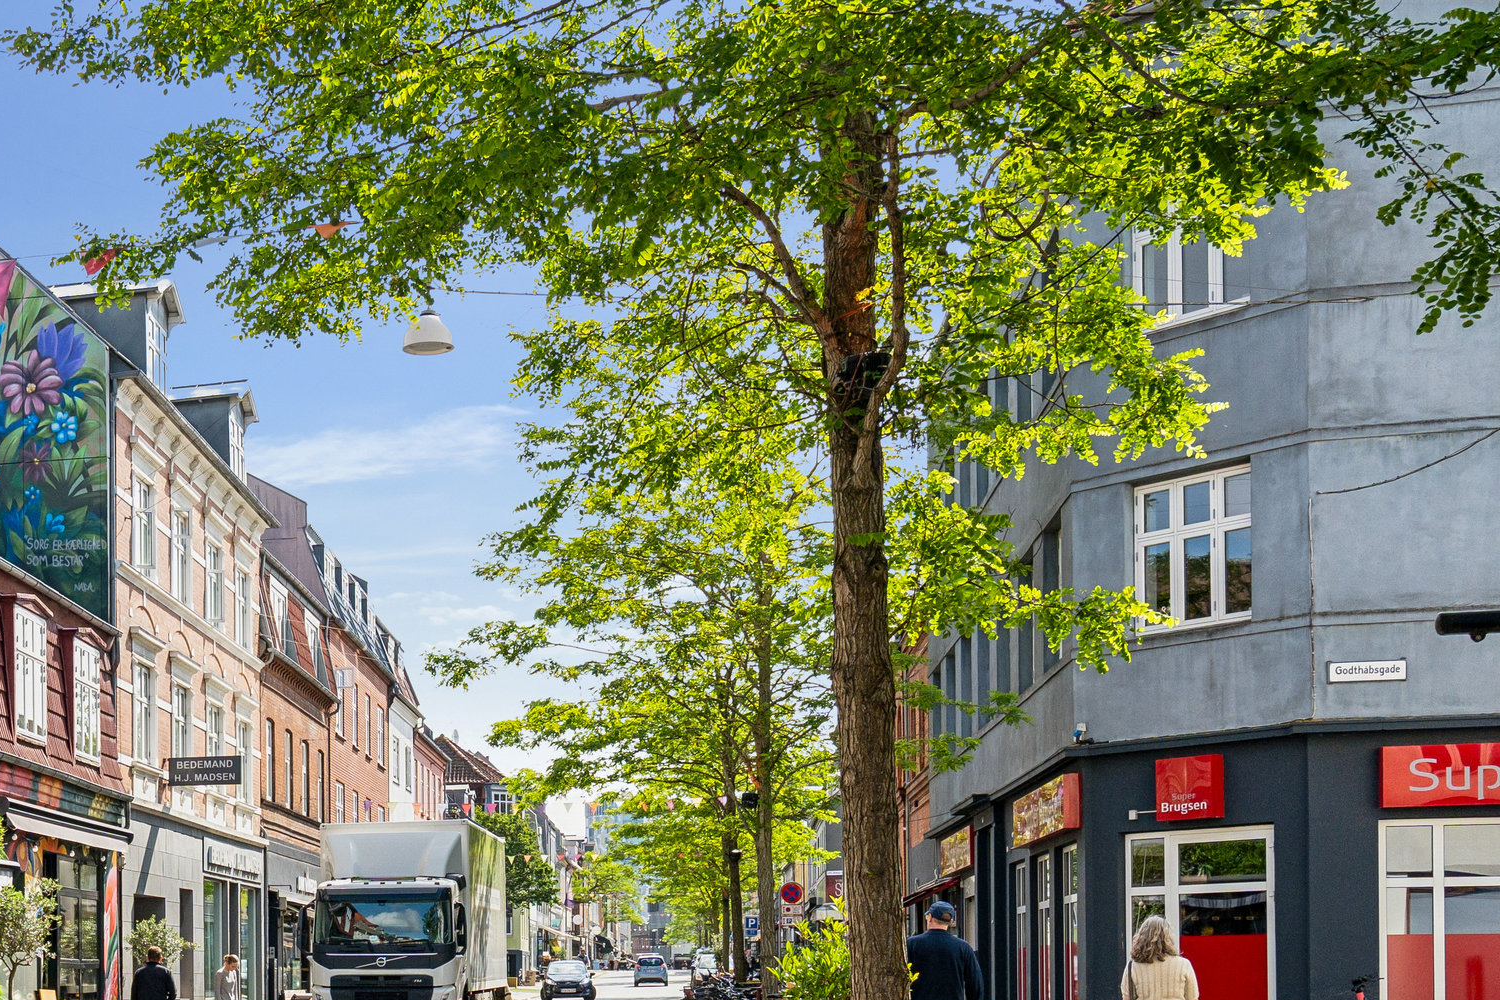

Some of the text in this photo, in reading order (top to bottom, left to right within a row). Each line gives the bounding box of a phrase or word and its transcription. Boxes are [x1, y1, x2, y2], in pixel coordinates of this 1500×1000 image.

[53, 540, 63, 550] ER
[26, 554, 48, 567] SOM
[1335, 664, 1401, 676] Godthåbsgade
[176, 759, 233, 769] BEDEMAND
[174, 772, 236, 782] H.J. MADSEN
[1172, 793, 1196, 801] Super
[1161, 801, 1207, 814] Brugsen
